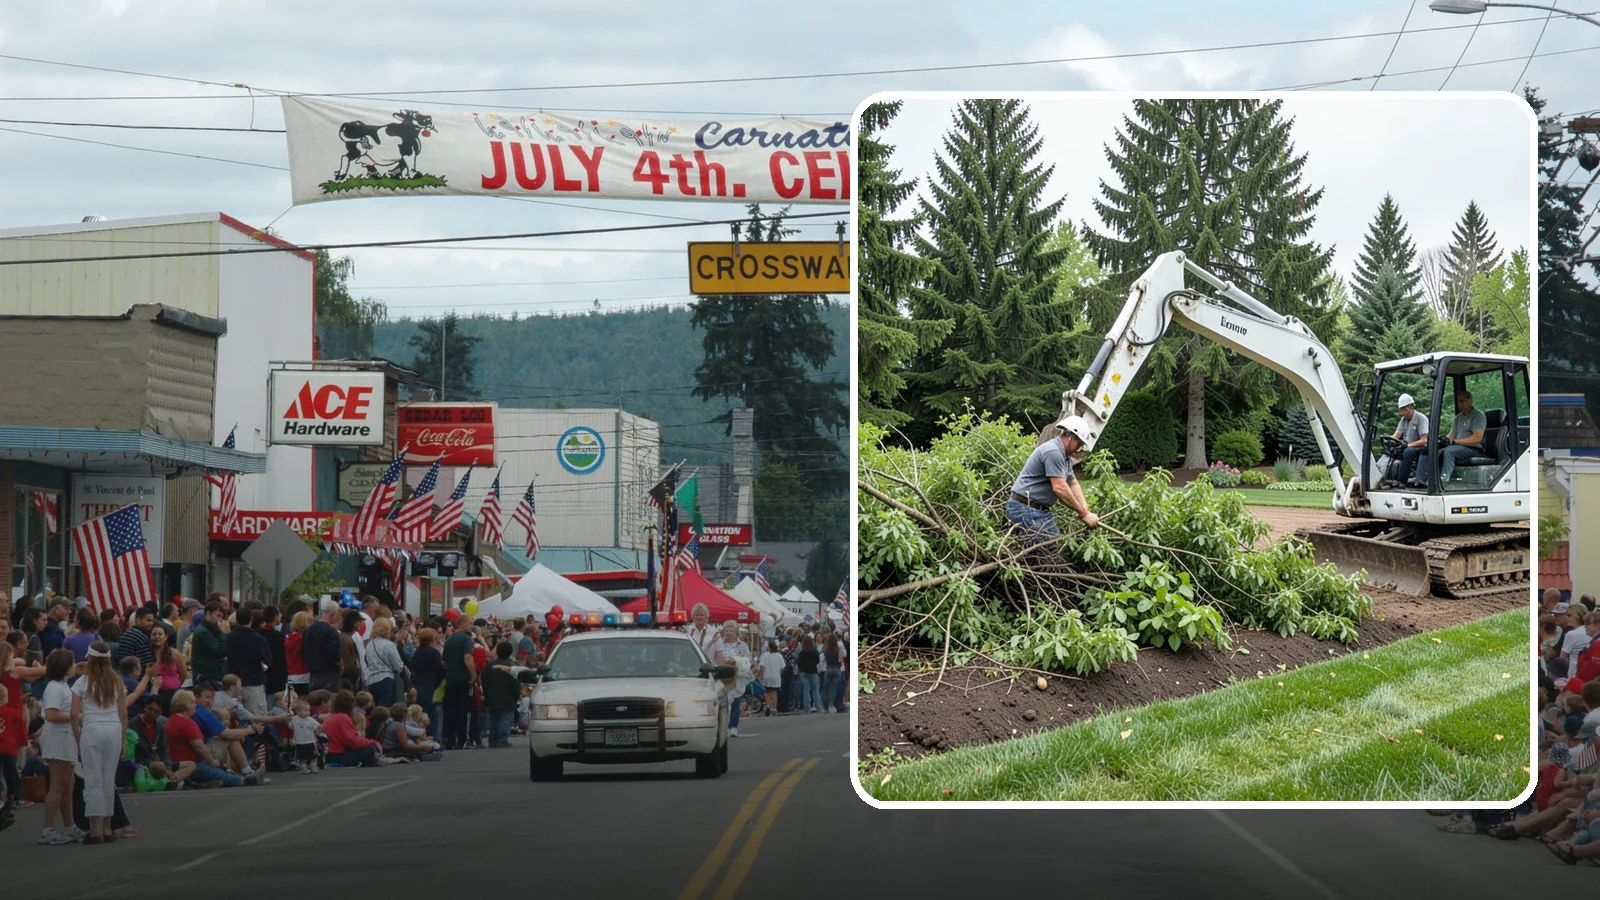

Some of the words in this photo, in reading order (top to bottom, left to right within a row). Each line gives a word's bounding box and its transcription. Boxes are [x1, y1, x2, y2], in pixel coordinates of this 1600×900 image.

[481, 141, 604, 192] JULY
[632, 150, 746, 197] 4th.
[697, 254, 850, 279] CROSSWA
[283, 380, 373, 419] ACE
[283, 421, 370, 436] Hardware
[96, 485, 124, 494] Vincent
[126, 486, 136, 494] de
[138, 486, 155, 495] Paul
[688, 526, 741, 534] CRNATION
[699, 535, 730, 543] GLASS
